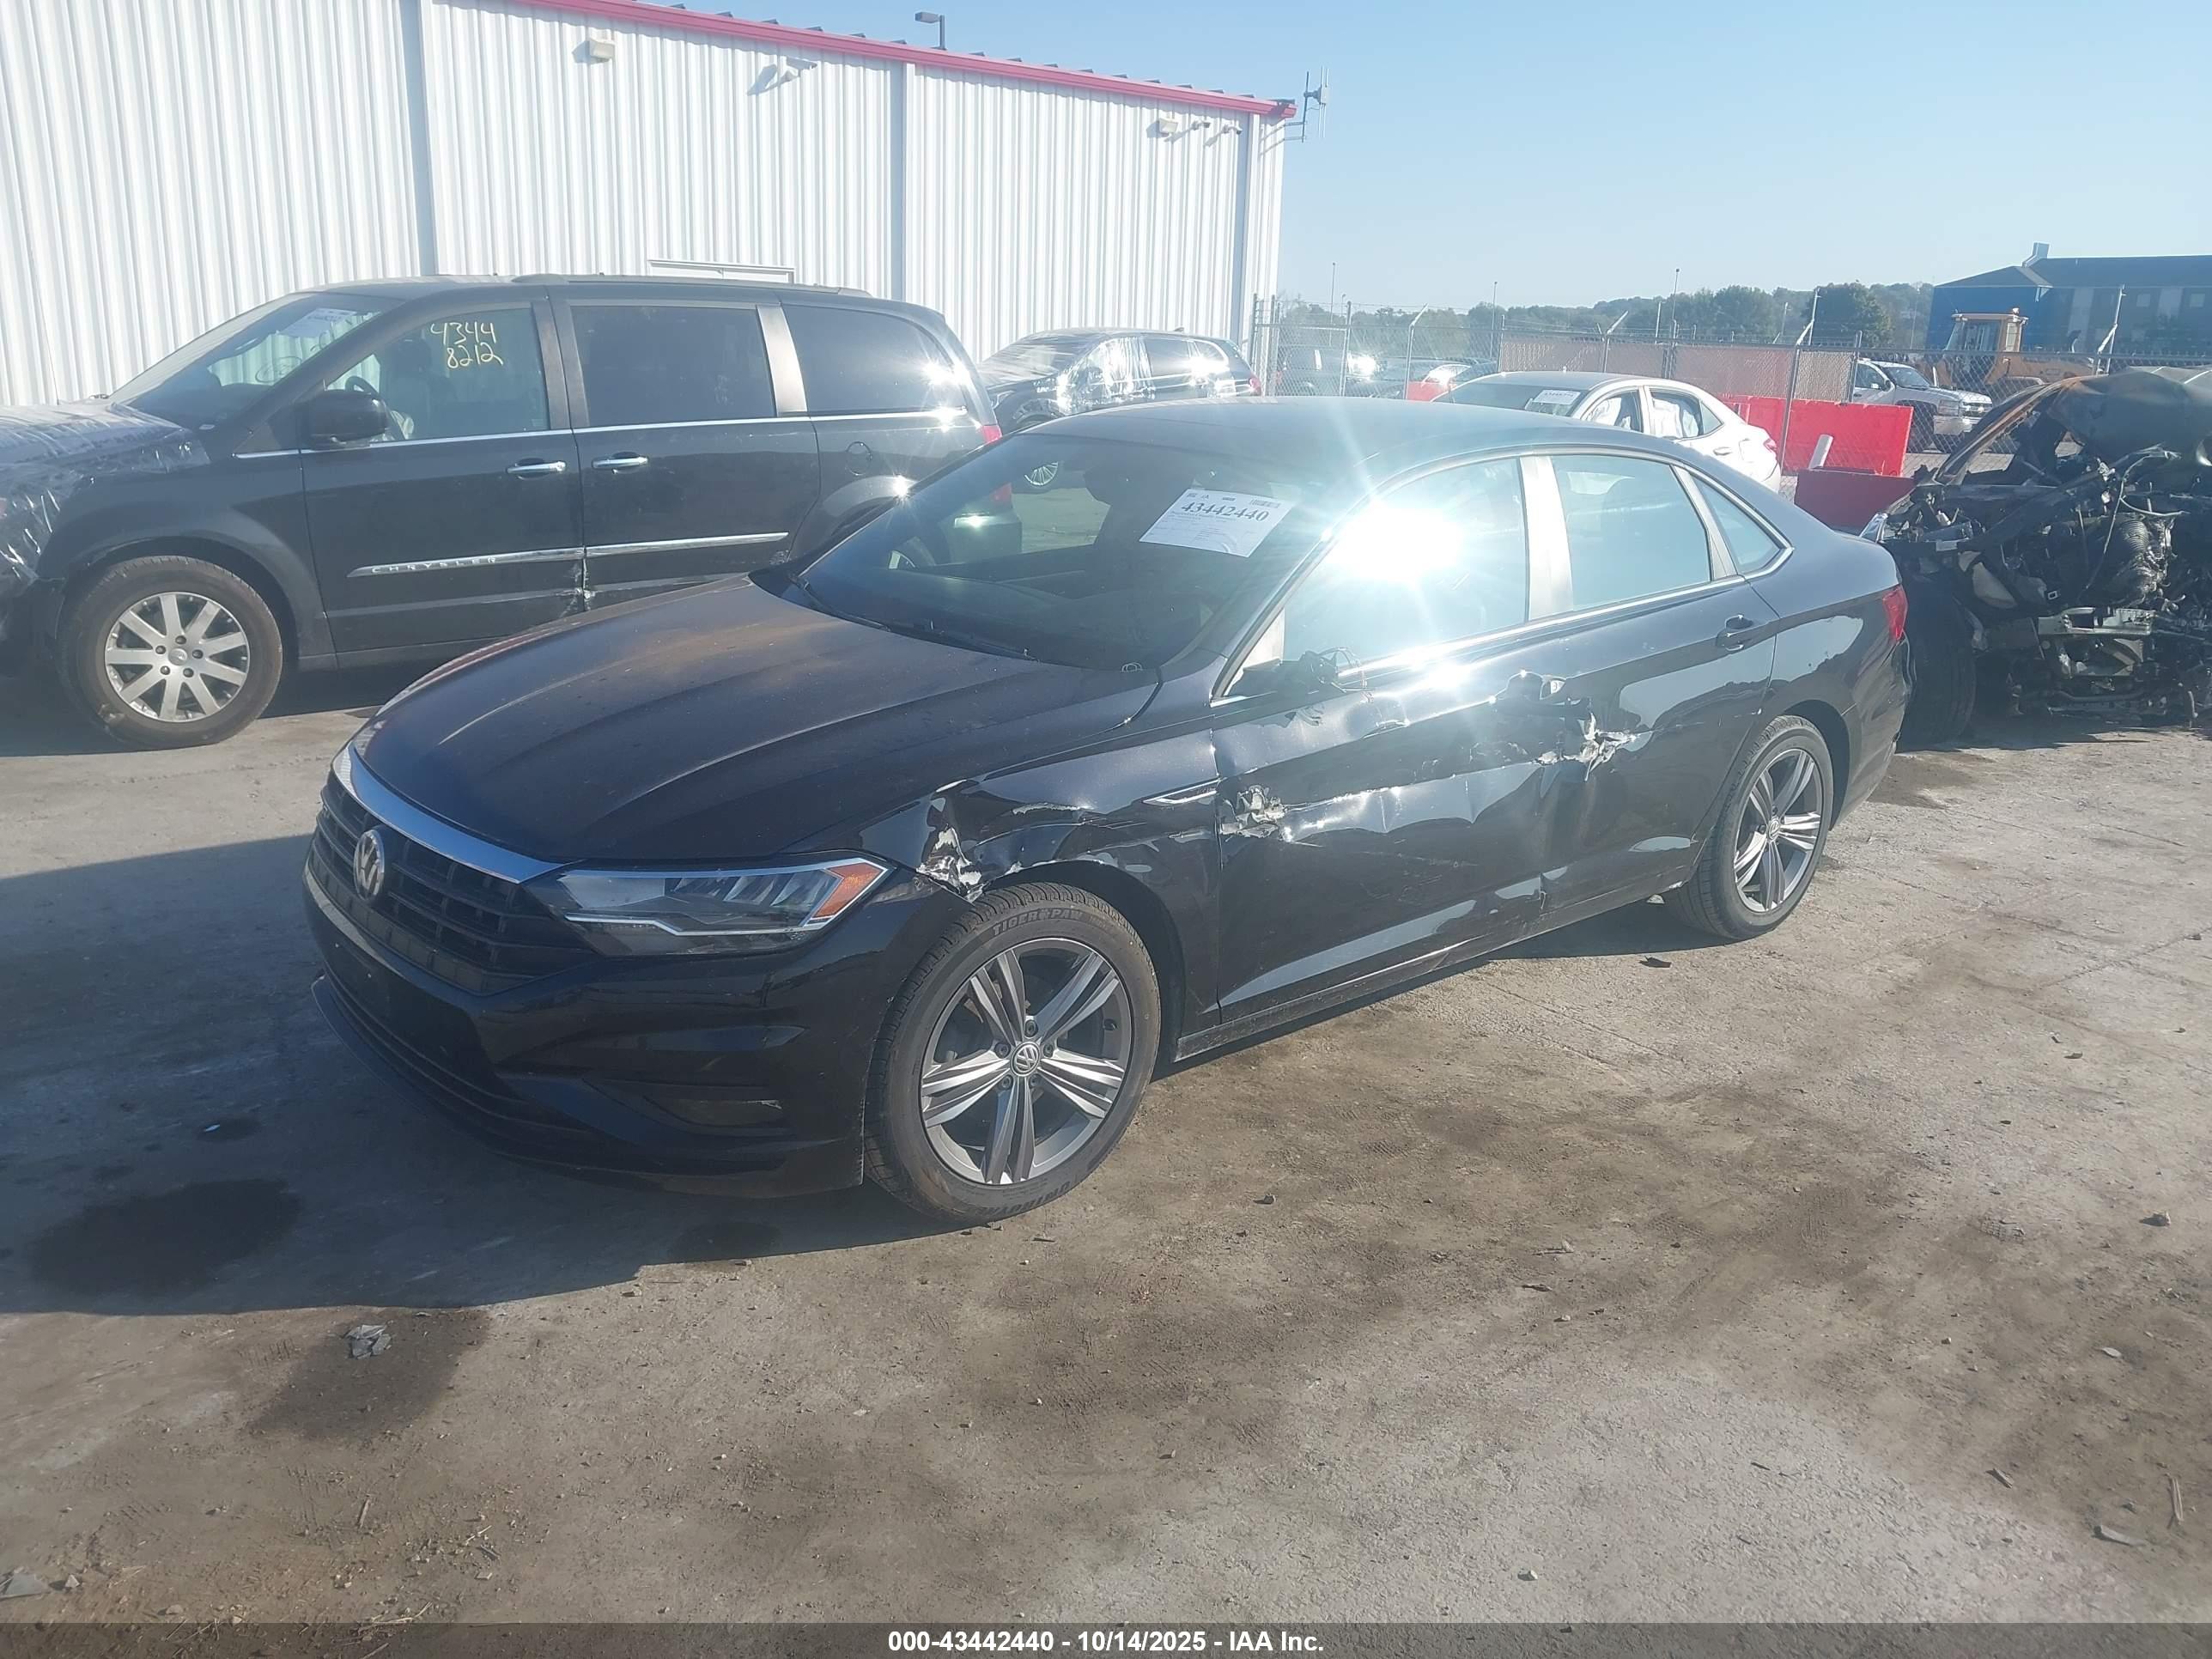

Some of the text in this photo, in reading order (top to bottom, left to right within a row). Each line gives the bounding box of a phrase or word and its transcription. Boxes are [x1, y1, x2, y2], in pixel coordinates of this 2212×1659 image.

[430, 321, 496, 345] 4344
[447, 342, 503, 368] 8212
[1182, 501, 1270, 522] 43442440
[371, 556, 495, 574] CHRYSLER
